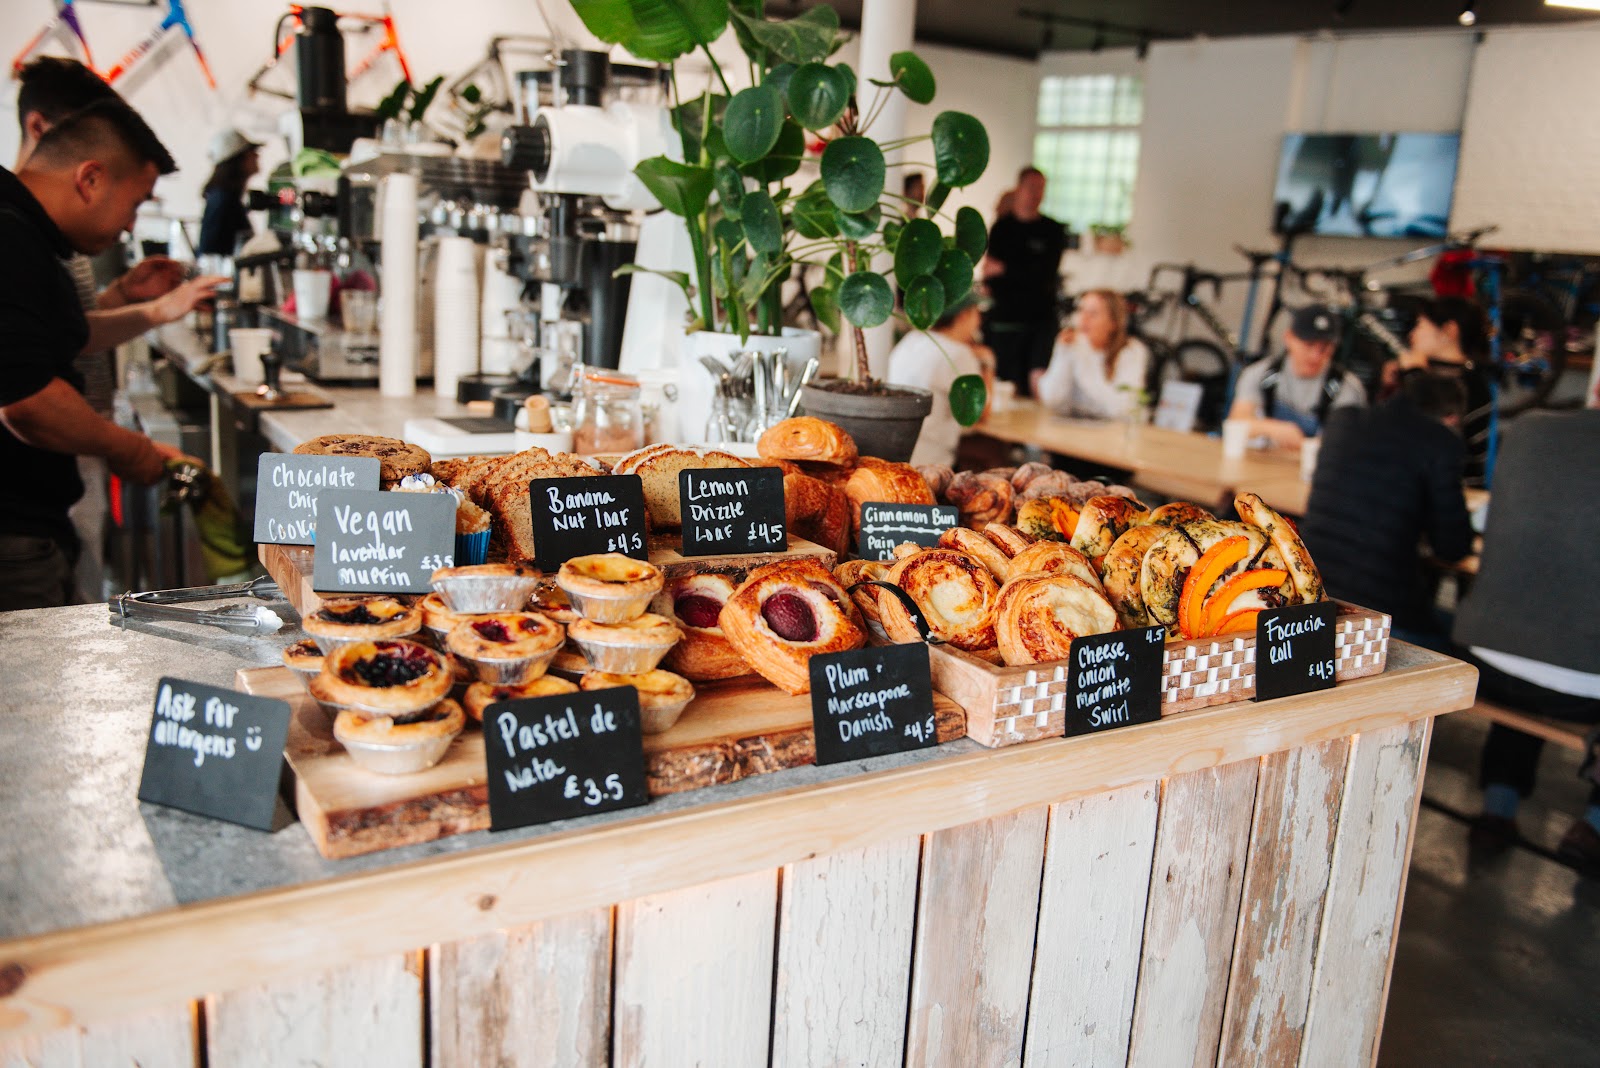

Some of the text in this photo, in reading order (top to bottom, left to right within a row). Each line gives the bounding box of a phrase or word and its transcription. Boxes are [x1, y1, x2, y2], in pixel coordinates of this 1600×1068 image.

[273, 463, 355, 487] Chocolate
[687, 473, 749, 501] Lemon
[546, 487, 616, 514] Banana
[689, 501, 744, 522] Drizzle
[269, 514, 316, 542] Cooki
[334, 505, 412, 549] Vegan
[552, 513, 587, 531] Nut
[865, 507, 956, 526] Cinnamon Bun
[608, 532, 642, 553] £4.5
[748, 522, 783, 544] £4.5
[867, 535, 895, 550] Pain
[1145, 628, 1164, 643] 4.5
[1264, 615, 1325, 641] Foccacia
[1078, 642, 1130, 668] Cheese,
[1270, 640, 1292, 664] Roll
[825, 663, 869, 693] Plum
[1309, 660, 1333, 680] £4.5
[157, 684, 196, 722] Ask
[827, 684, 910, 714] Marscapone
[839, 711, 894, 742] Danish
[1088, 700, 1129, 727] Swirl
[498, 703, 617, 758] Pastel de
[904, 715, 934, 742] £4.5
[155, 720, 236, 767] allergens
[564, 774, 623, 806] £3.5
